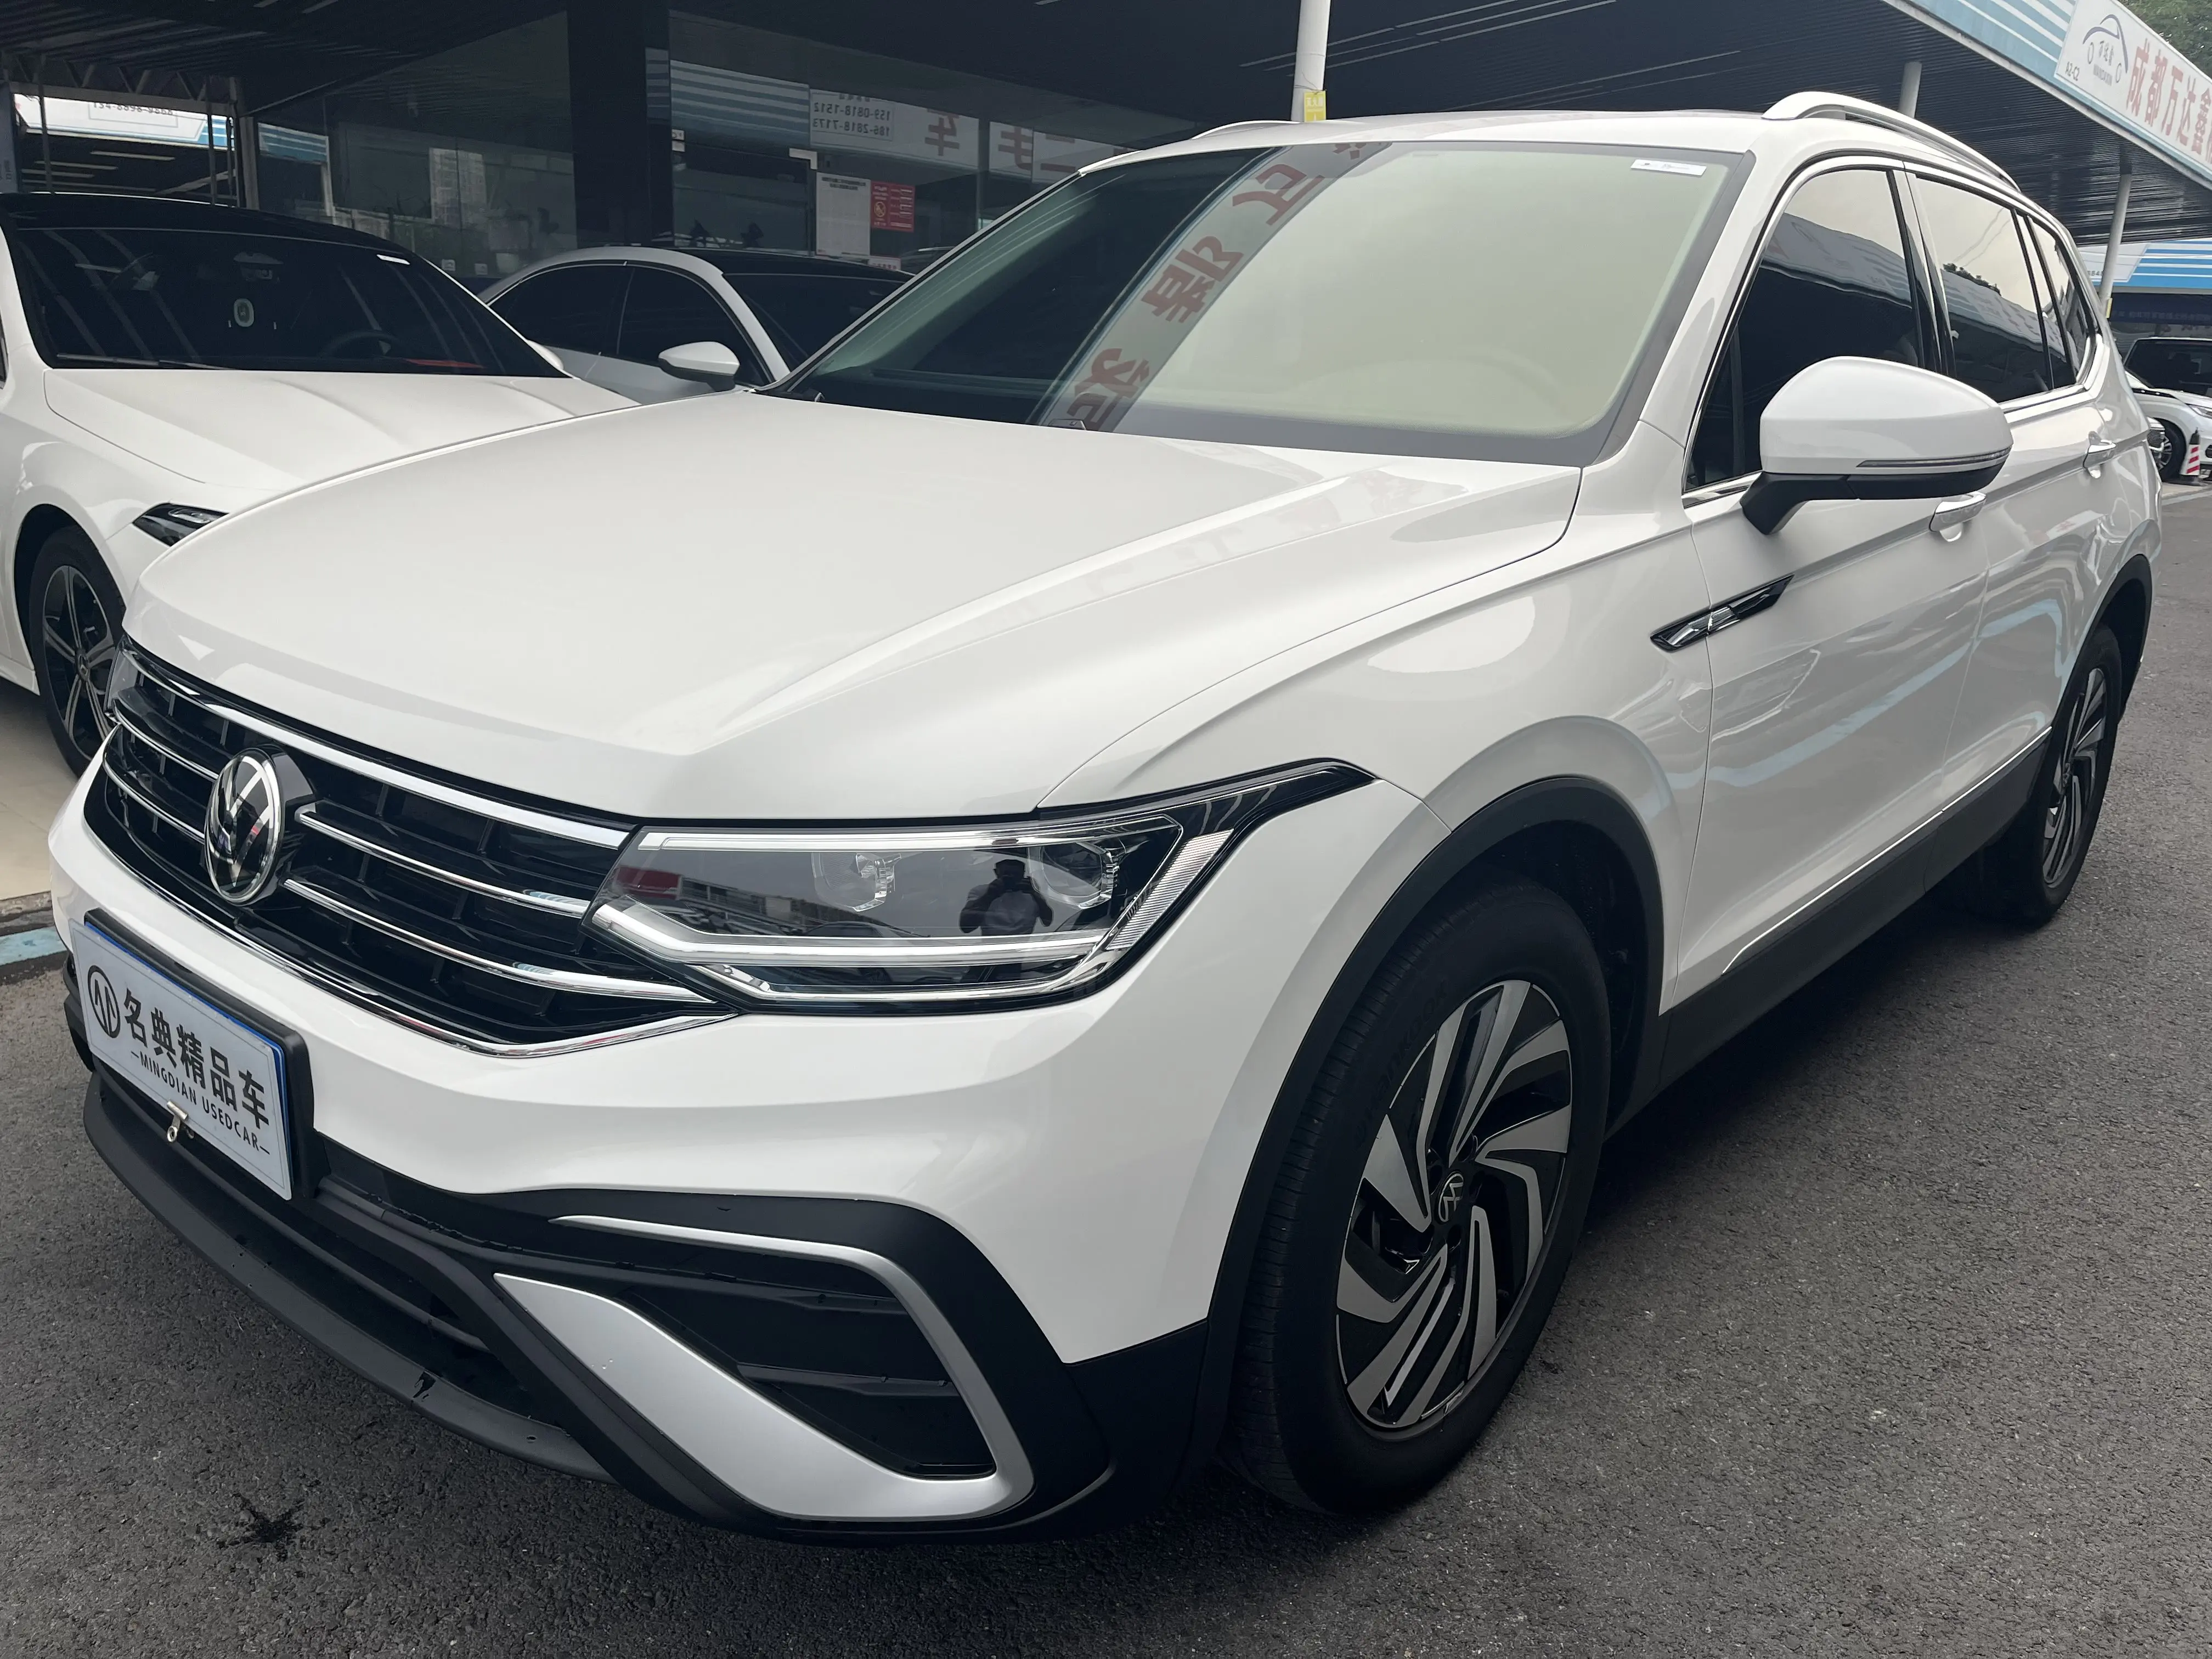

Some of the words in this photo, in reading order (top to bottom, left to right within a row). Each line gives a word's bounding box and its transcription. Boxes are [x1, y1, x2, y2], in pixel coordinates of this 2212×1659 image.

[2126, 40, 2212, 165] 成都万达鑫
[122, 988, 269, 1130] 名典精品车
